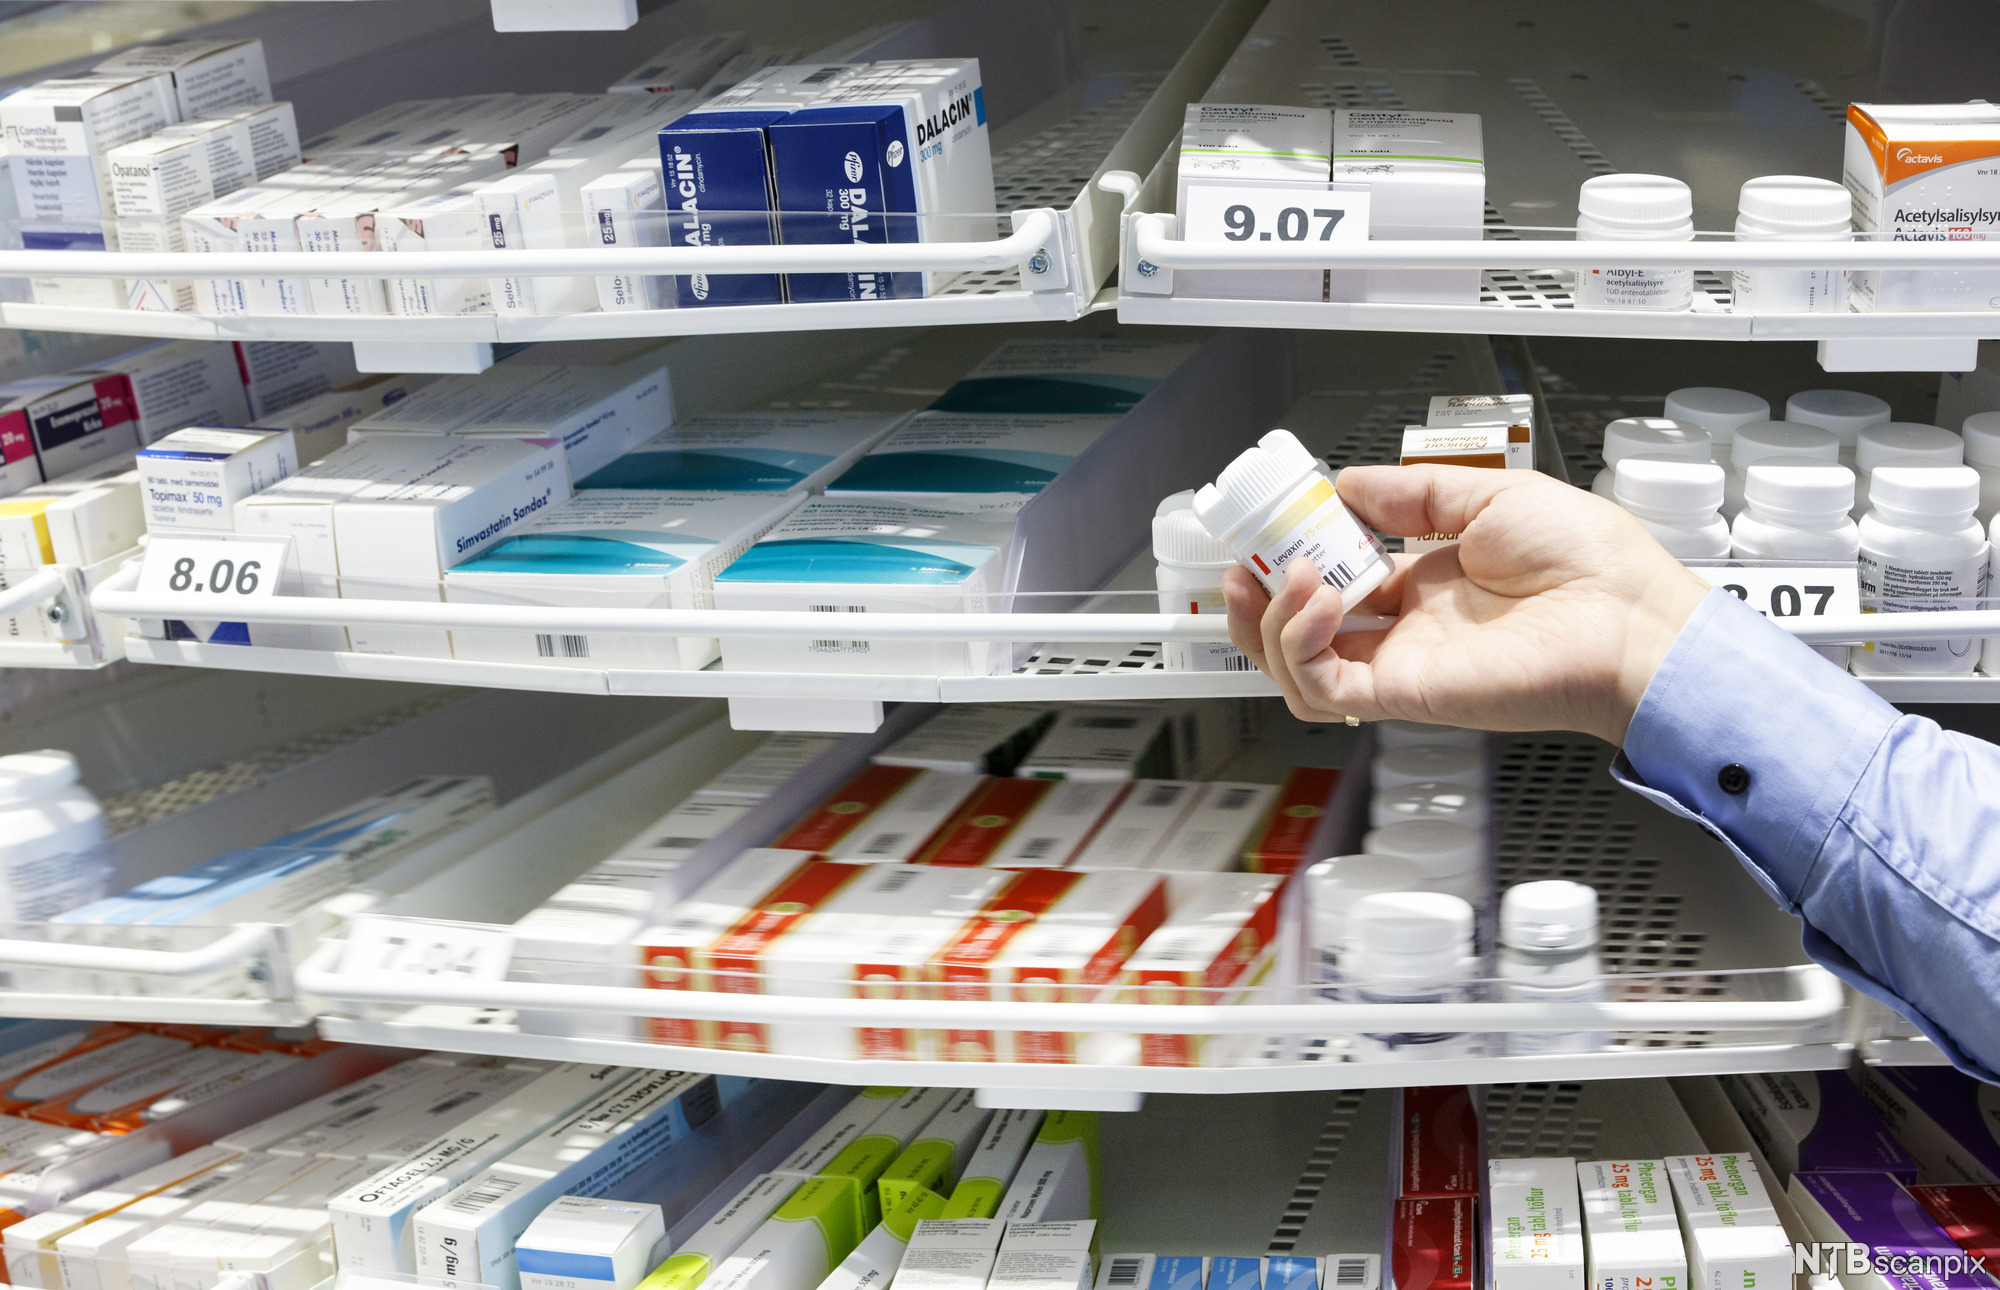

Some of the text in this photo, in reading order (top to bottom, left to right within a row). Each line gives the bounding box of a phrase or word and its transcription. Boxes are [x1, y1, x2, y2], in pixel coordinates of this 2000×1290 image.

[917, 92, 973, 146] DALACIN®
[920, 140, 943, 163] 300 mg
[1905, 154, 1942, 164] actavis
[845, 154, 858, 182] Pfizer
[674, 146, 702, 246] ALACIN®
[826, 188, 832, 199] 32
[838, 188, 850, 231] 300 mg
[494, 217, 504, 246] 25 mg
[603, 212, 614, 244] 25 mg
[701, 224, 712, 242] mg
[1224, 204, 1345, 241] 9.07
[1894, 228, 1986, 241] Actavis 160 mg
[2, 431, 14, 446] 20
[193, 492, 204, 504] 50
[206, 494, 222, 508] mg
[456, 514, 512, 554] Simvastatin
[1272, 537, 1304, 567] Levaxin
[1303, 527, 1316, 542] 75
[169, 556, 262, 595] 8.06
[1888, 566, 1913, 574] filmdrasjert
[1891, 584, 1932, 593] pakningsvedlegget
[1896, 589, 1932, 597] oppmerksomhet
[1883, 601, 1909, 610] Oppbevares
[360, 1164, 425, 1203] OFTAGEL
[1637, 1162, 1658, 1204] Phenergan
[1696, 1156, 1736, 1226] 25 mg tabl./töflur
[1720, 1155, 1748, 1196] Phenergan
[1612, 1163, 1643, 1233] 25 mg tabl./töflur
[1506, 1216, 1526, 1260] Phenergan
[1526, 1188, 1552, 1259] 25 mg tabl./töflur
[440, 1238, 459, 1276] mg/g
[531, 1278, 541, 1286] Vnr
[858, 1268, 880, 1288] 500 mg
